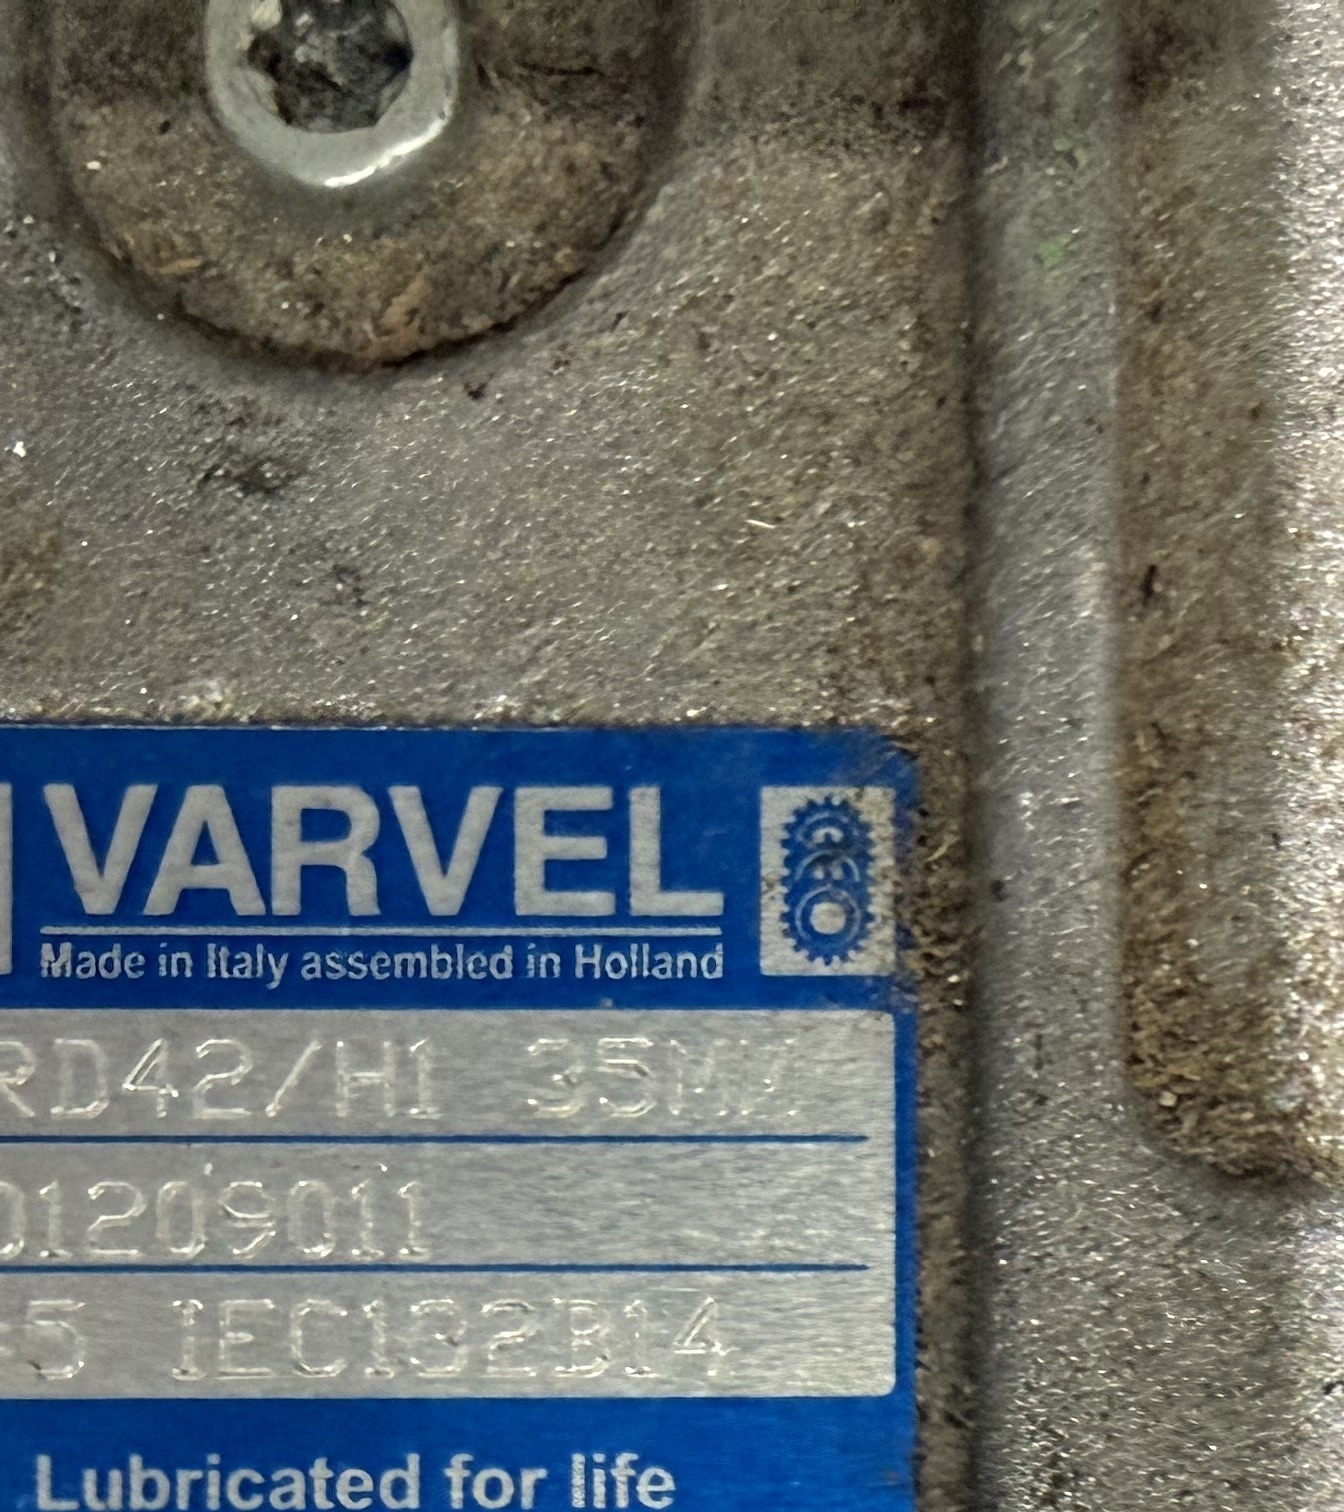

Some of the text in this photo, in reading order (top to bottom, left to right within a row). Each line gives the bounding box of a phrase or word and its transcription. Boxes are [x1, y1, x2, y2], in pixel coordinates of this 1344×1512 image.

[42, 783, 724, 916] VARVEL
[39, 942, 723, 988] Made in Italy assembled in Holland
[170, 1297, 738, 1380] IEC132B14
[37, 1453, 676, 1512] Lubricated for life
